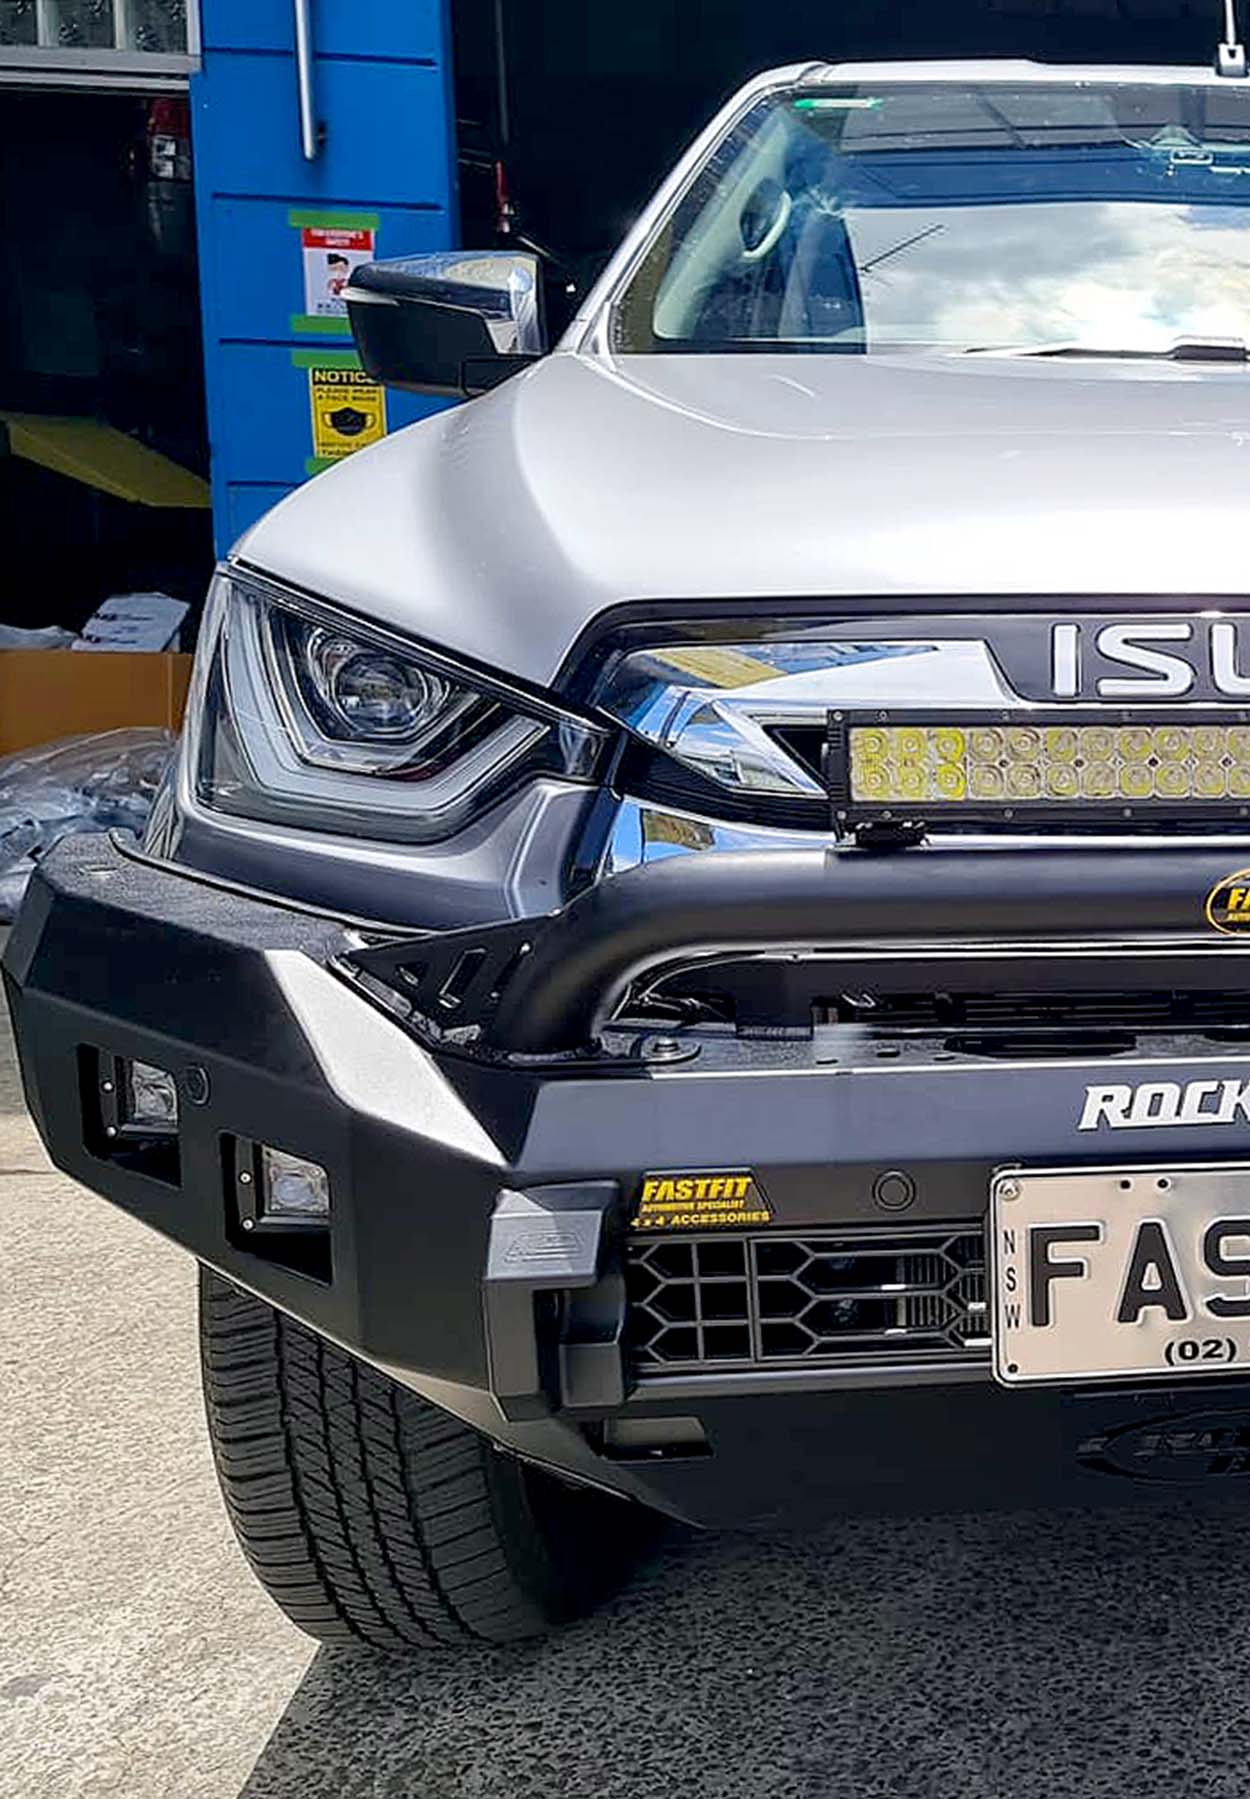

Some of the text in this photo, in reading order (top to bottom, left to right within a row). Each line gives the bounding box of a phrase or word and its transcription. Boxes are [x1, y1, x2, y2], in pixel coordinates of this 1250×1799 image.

[642, 1176, 752, 1202] FASTFIT
[671, 1211, 771, 1226] ACCESSORIES
[1164, 1340, 1238, 1367] (02)
